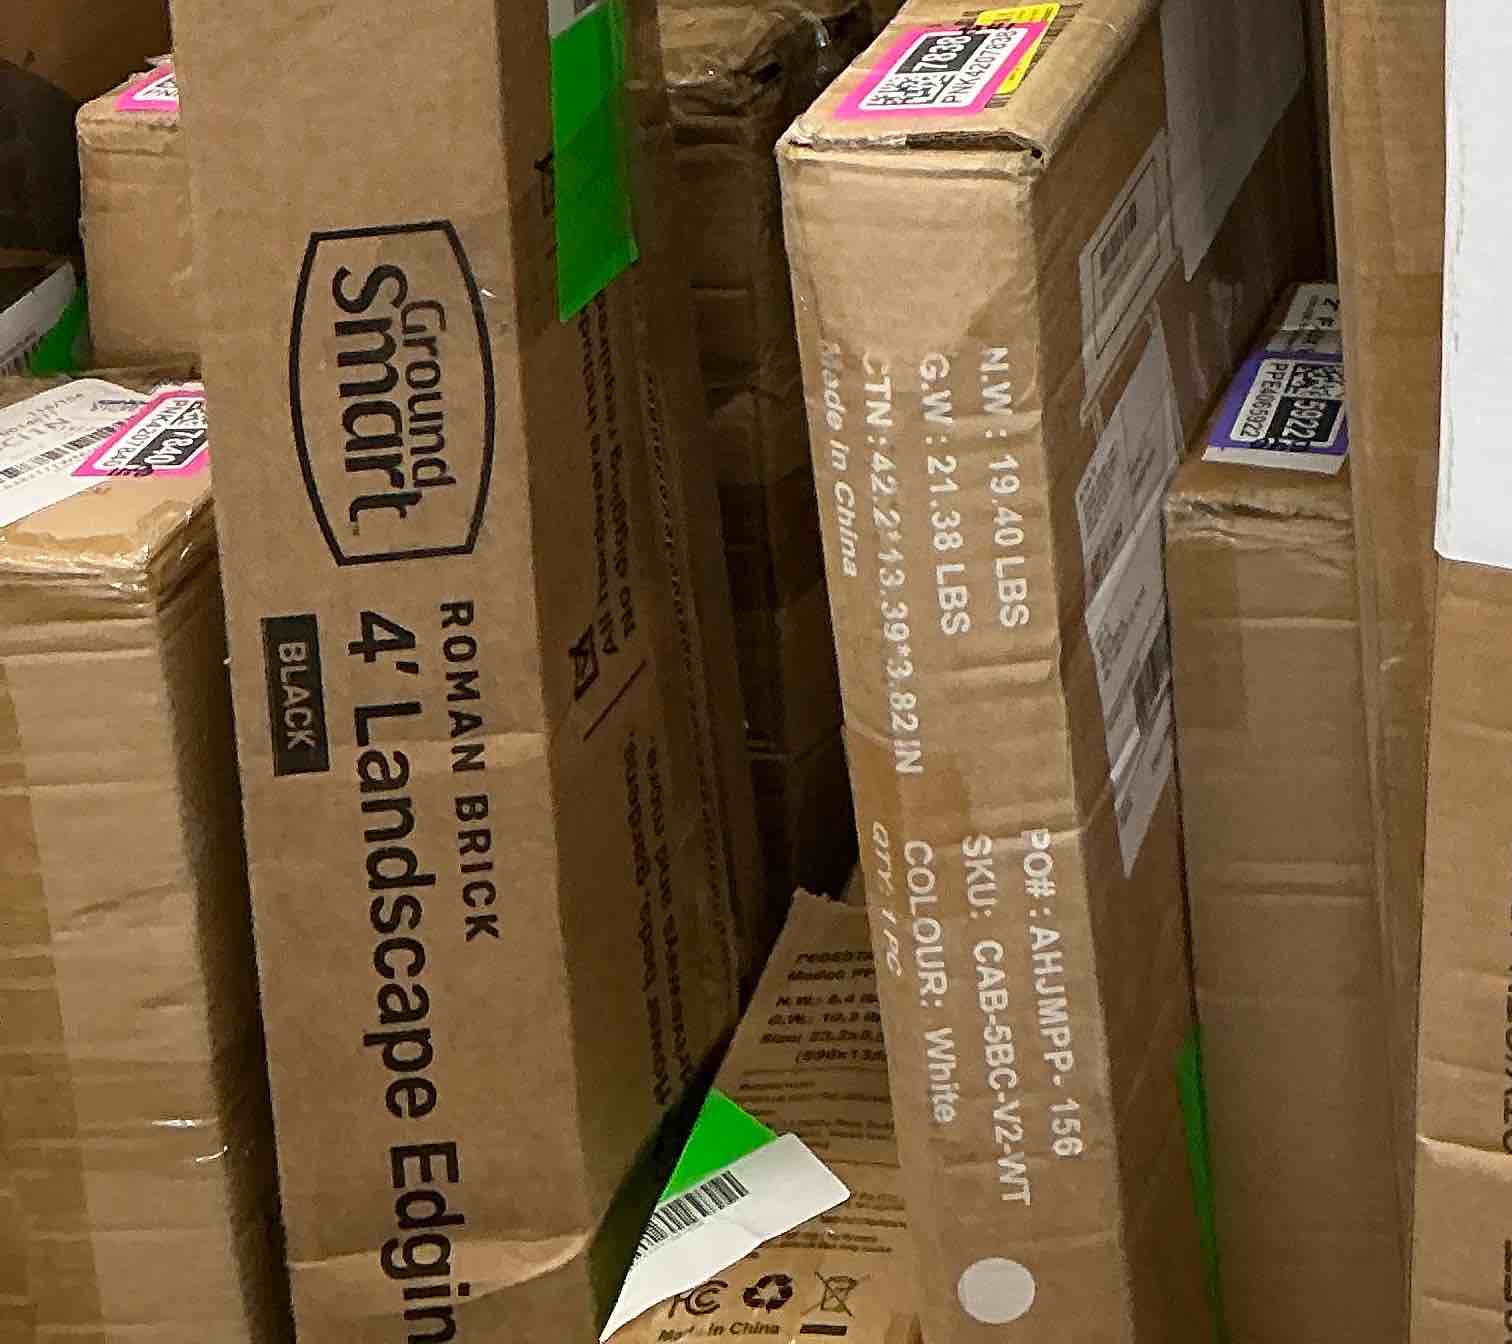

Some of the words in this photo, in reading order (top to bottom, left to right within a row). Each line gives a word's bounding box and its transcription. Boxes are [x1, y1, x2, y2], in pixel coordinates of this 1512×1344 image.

[913, 34, 972, 75] 7838
[330, 262, 425, 523] Smart
[401, 301, 456, 490] Ground
[926, 454, 964, 553] 21.38
[989, 454, 1025, 546] 19.40
[347, 609, 419, 676] 4'
[936, 561, 971, 636] LBS
[993, 556, 1030, 628] LBS
[278, 640, 317, 751] BLACK
[438, 599, 488, 774] ROMAN
[352, 700, 438, 1120] Landscape
[452, 793, 501, 943] BRICK
[961, 834, 993, 919] SKU:
[903, 838, 949, 1009] COLOUR:
[922, 1026, 962, 1125] White
[973, 938, 1031, 1207] CAB-5BC-V2-WT
